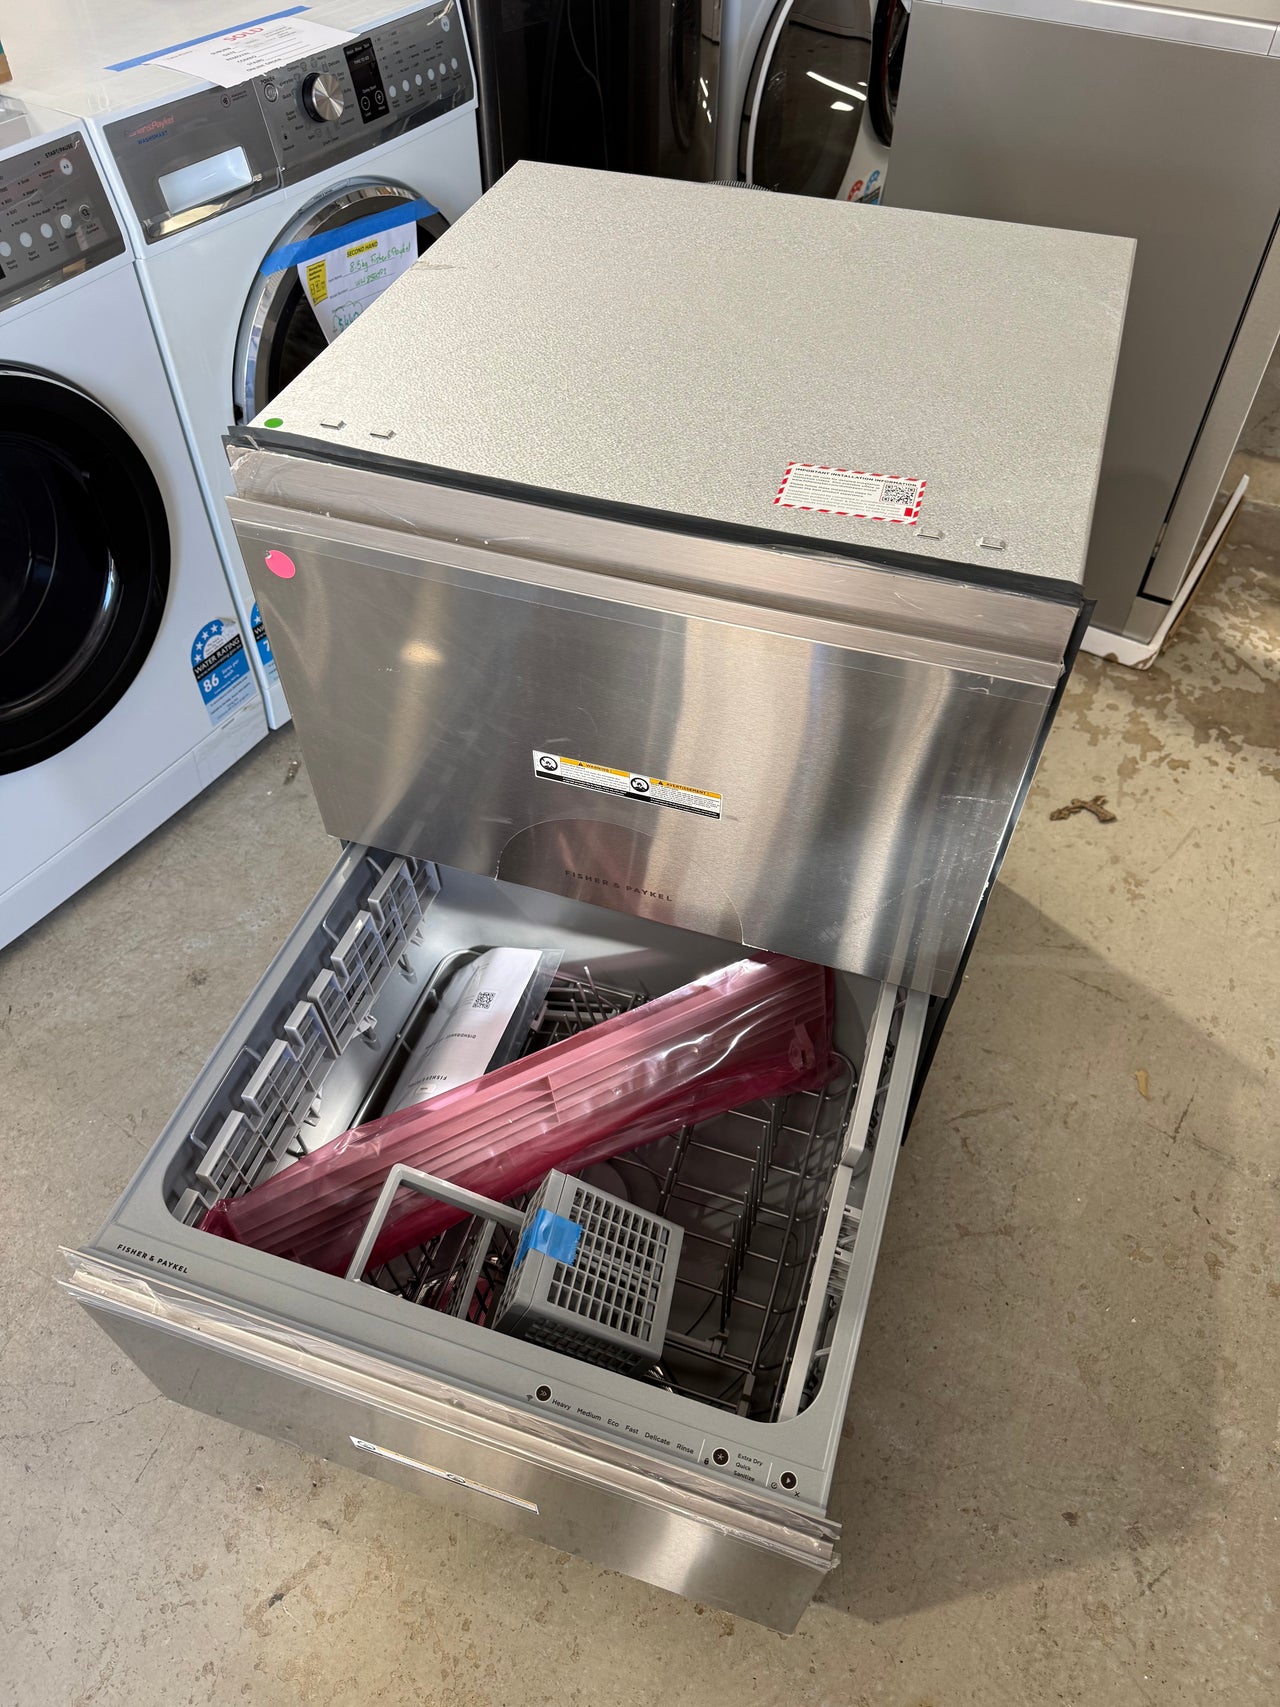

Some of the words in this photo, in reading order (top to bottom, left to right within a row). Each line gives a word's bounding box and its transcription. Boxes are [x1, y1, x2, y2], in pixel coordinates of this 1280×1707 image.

[224, 27, 264, 42] SOLD
[45, 143, 73, 158] START/PAUSE
[346, 246, 364, 258] SECOND
[364, 241, 378, 251] HAND
[795, 467, 830, 476] IMPORTANT
[831, 472, 874, 482] INSTALLATION
[875, 478, 917, 487] INFORMATION
[194, 656, 218, 674] WATER
[217, 637, 240, 656] RATING
[203, 673, 219, 692] 86
[667, 782, 706, 795] AVERTISSEMENT
[565, 870, 609, 885] FISHER
[626, 885, 673, 902] PAYKEL
[117, 1244, 147, 1259] FISHER
[157, 1258, 188, 1274] PAYKEL
[552, 1399, 571, 1411] Heavy
[577, 1407, 602, 1421] Medium
[607, 1418, 619, 1428] Eco
[625, 1425, 639, 1435] Fast
[644, 1431, 671, 1446] Delicate
[677, 1443, 694, 1455] Rinse
[736, 1462, 751, 1472] Quick
[738, 1453, 752, 1462] Extra
[752, 1458, 763, 1467] Dry
[733, 1470, 755, 1482] Sanitize
